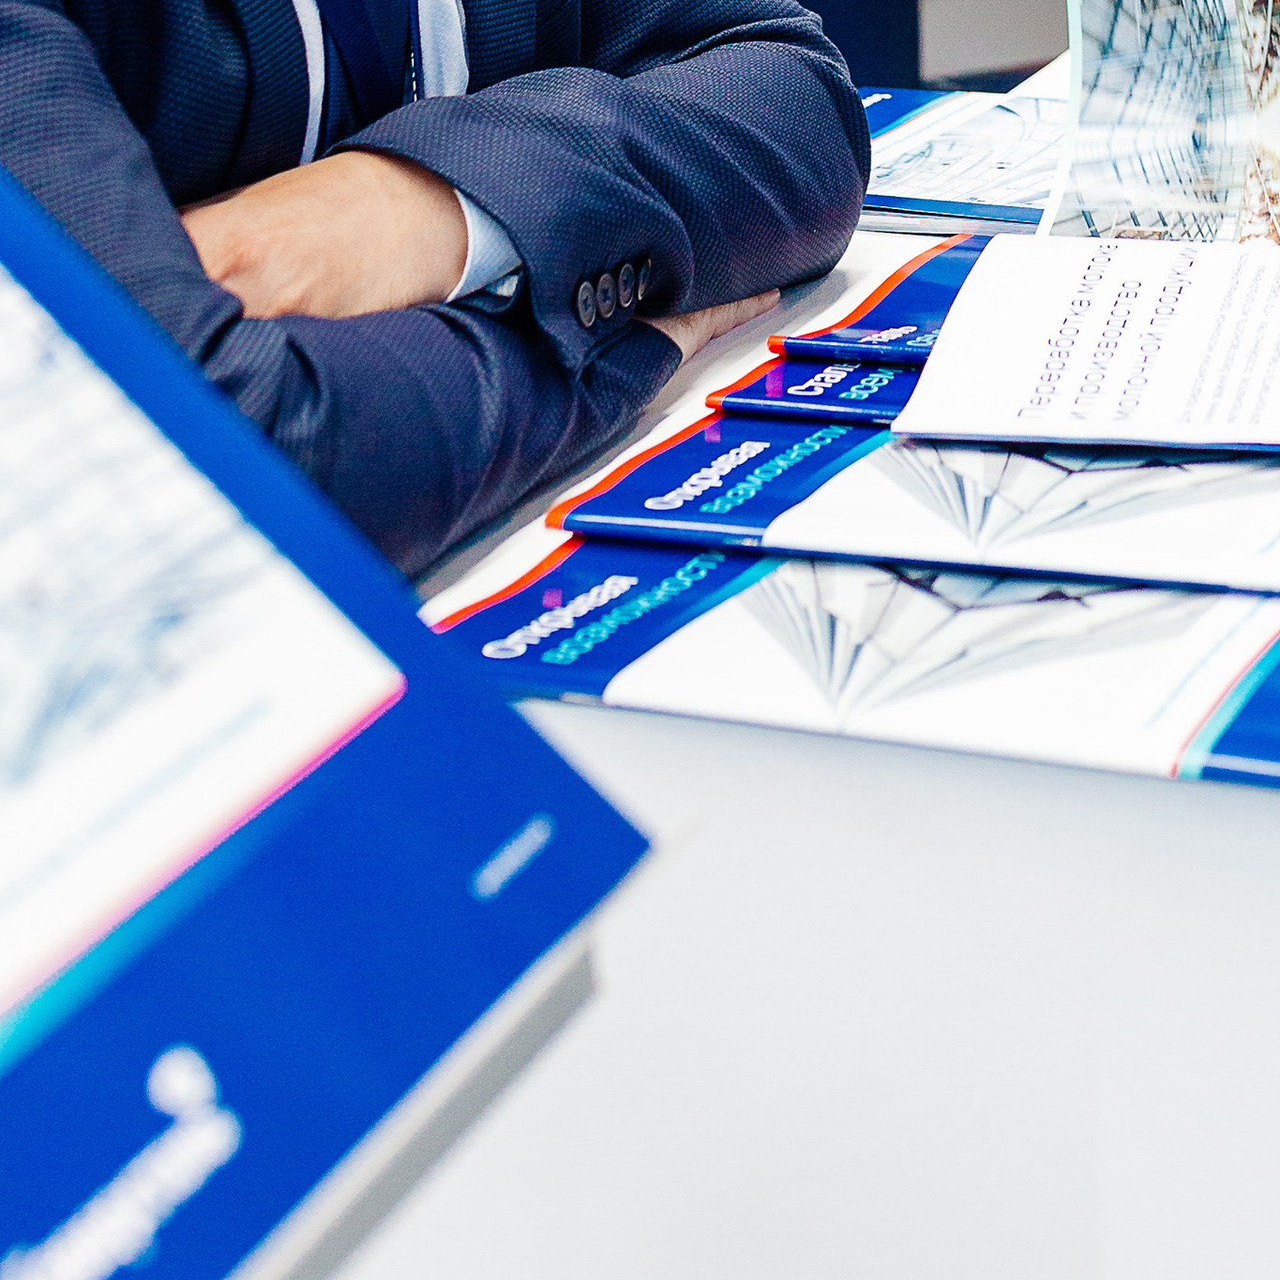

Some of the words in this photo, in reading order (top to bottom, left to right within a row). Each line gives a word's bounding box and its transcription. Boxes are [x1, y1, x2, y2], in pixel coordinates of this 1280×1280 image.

[1017, 298, 1092, 419] Переработка
[1073, 279, 1143, 407] производство
[1111, 332, 1164, 422] молочной
